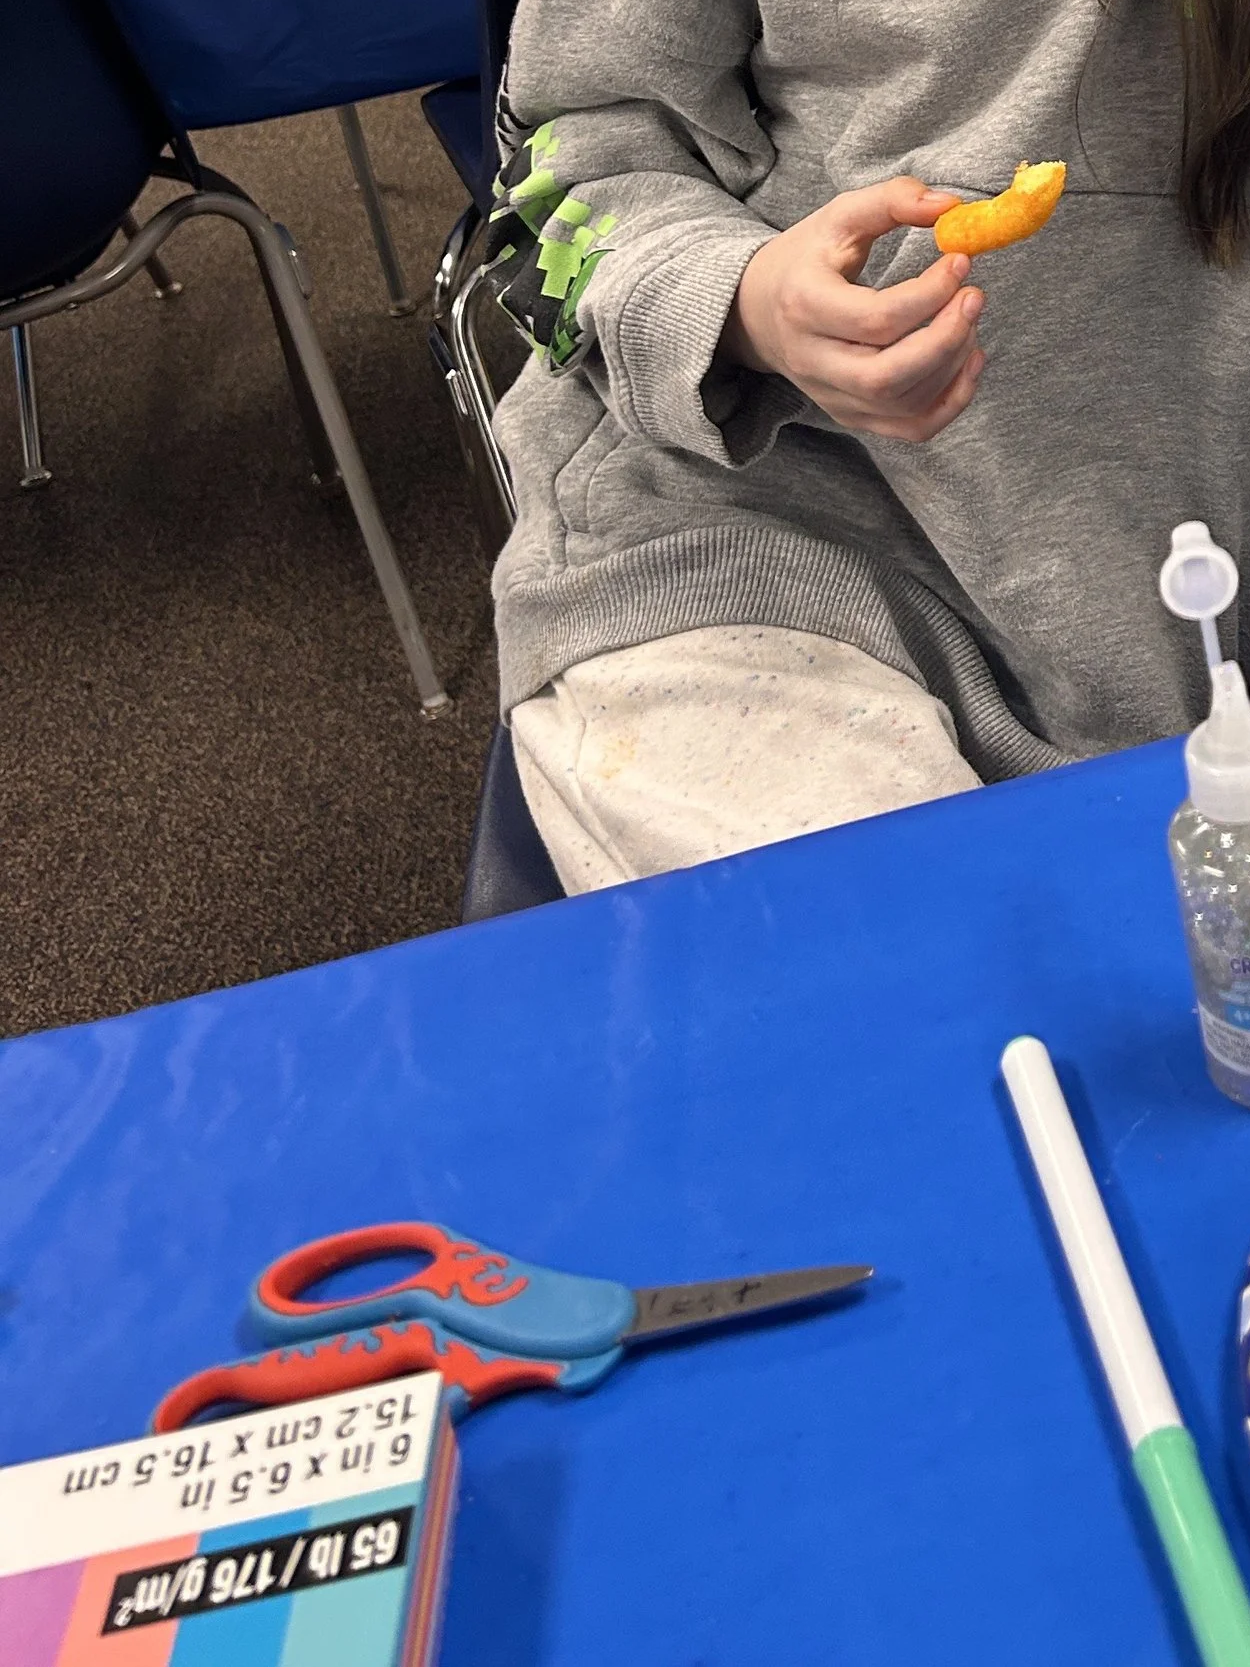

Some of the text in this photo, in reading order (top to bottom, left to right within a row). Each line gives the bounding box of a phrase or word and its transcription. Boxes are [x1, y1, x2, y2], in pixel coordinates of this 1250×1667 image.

[61, 1392, 417, 1497] 15.2 cm x 16.5 cm
[179, 1432, 413, 1511] 6 in x 6.5 in
[278, 1536, 308, 1589] /
[308, 1530, 347, 1579] lb
[351, 1518, 401, 1570] 65
[209, 1547, 277, 1604] 176
